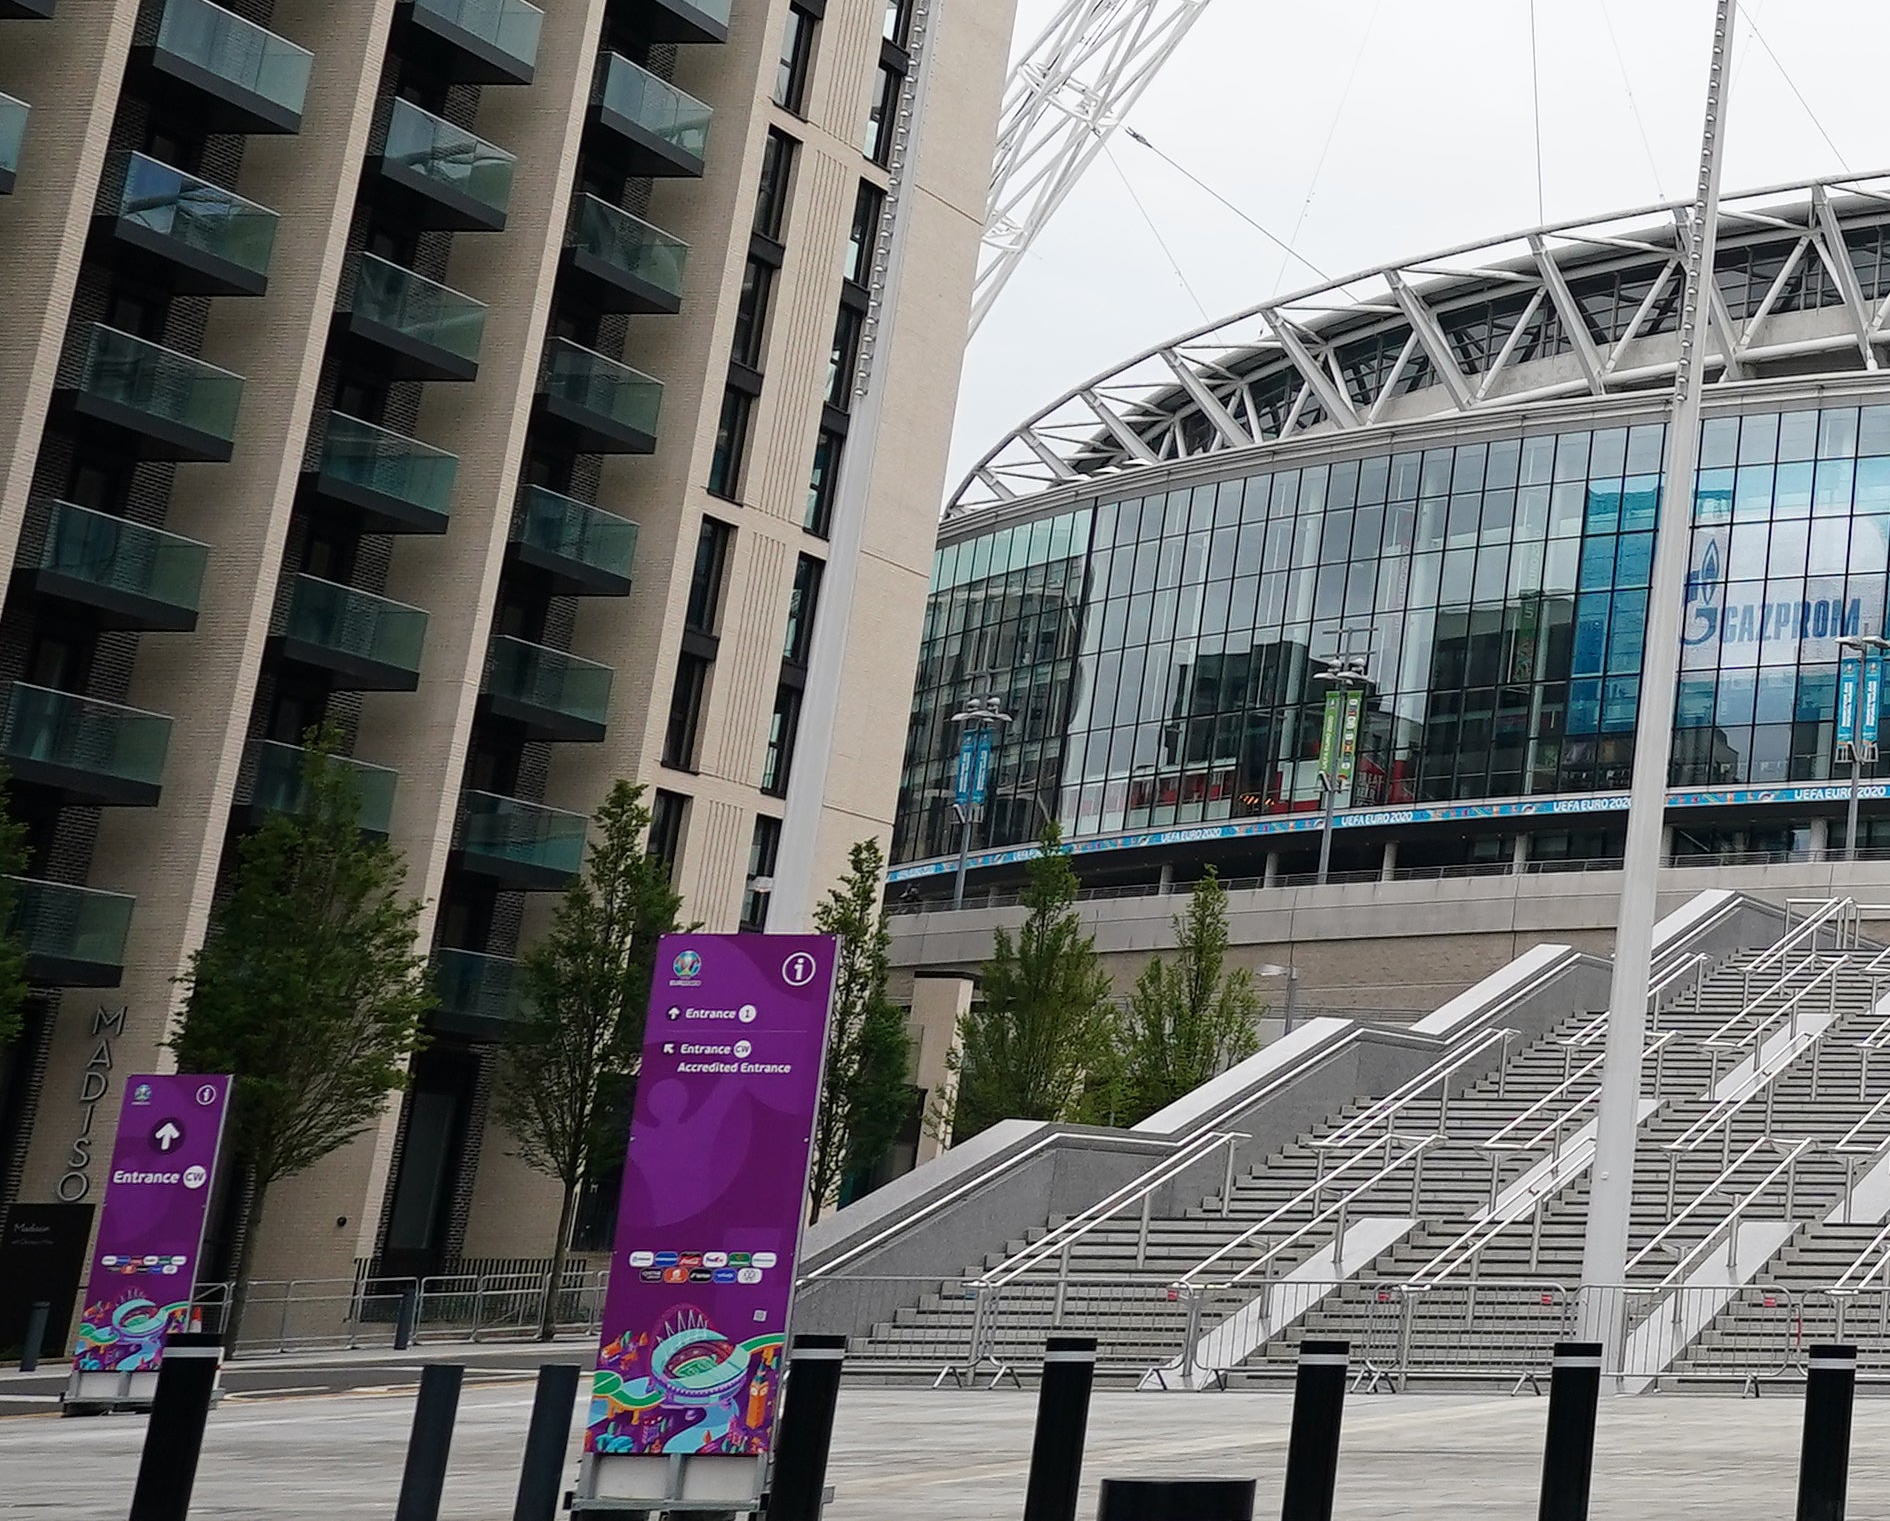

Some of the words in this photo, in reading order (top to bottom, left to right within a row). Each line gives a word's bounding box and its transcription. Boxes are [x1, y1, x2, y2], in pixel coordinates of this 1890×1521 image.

[1723, 598, 1861, 643] GAZPROM
[1794, 788, 1824, 800] UEFA
[1857, 786, 1886, 797] 2020
[1553, 801, 1580, 812] UEFA
[1581, 799, 1608, 811] EURO
[1341, 814, 1365, 826] UEFA
[685, 1007, 736, 1019] Entrance
[680, 1043, 731, 1055] Entrance
[677, 1062, 738, 1073] Accredited
[740, 1062, 791, 1073] Entrance
[113, 1170, 181, 1184] Entrance
[185, 1171, 206, 1182] CW
